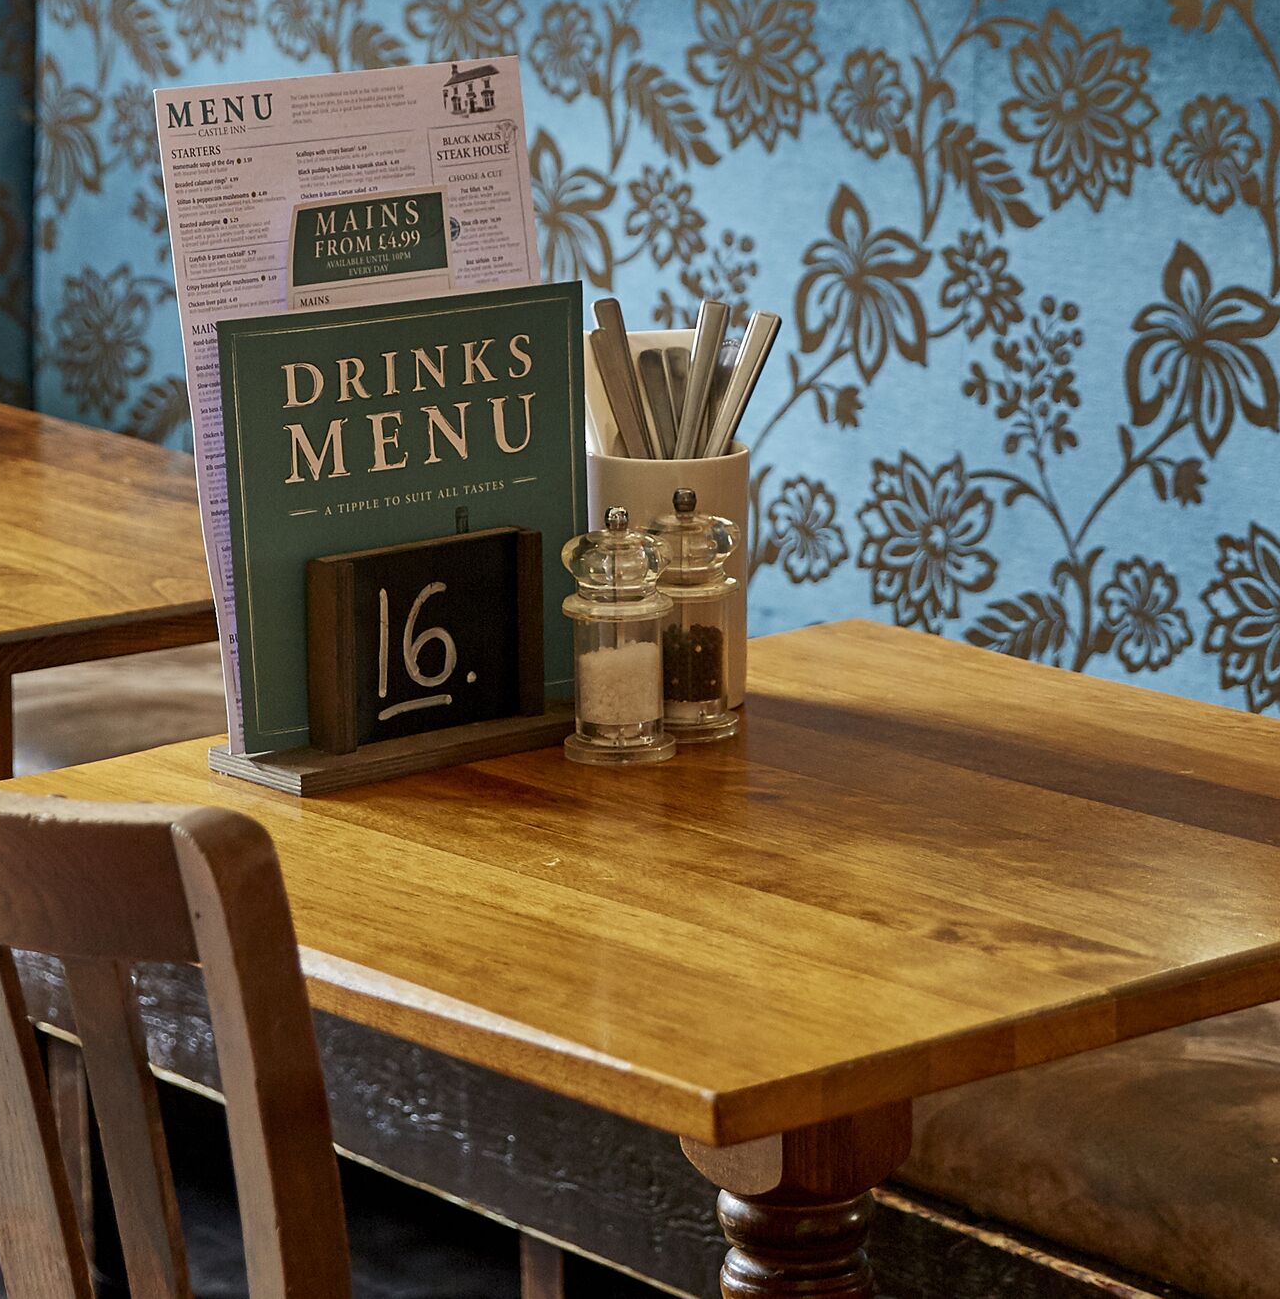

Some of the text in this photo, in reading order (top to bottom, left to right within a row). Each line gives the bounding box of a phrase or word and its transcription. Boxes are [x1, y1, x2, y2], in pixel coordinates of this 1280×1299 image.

[166, 93, 272, 128] MENU
[198, 125, 246, 137] CASTLE INN
[442, 131, 501, 146] BLACK ANGUS
[171, 145, 221, 159] STARTERS
[436, 143, 510, 161] STEAK HOUSE
[448, 173, 478, 182] CHOOSE
[487, 170, 502, 178] CUT
[314, 199, 420, 237] MAINS
[314, 229, 420, 258] FROM £4.99
[326, 251, 411, 269] AVAILABLE UNTIL 10PM
[348, 264, 389, 277] EVERY DAY
[300, 295, 330, 308] MAINS
[192, 323, 218, 335] MAIN
[281, 333, 534, 409] DRINKS
[282, 392, 536, 484] MENU
[324, 480, 506, 516] A TIPPLE TO SUIT ALL TASTES
